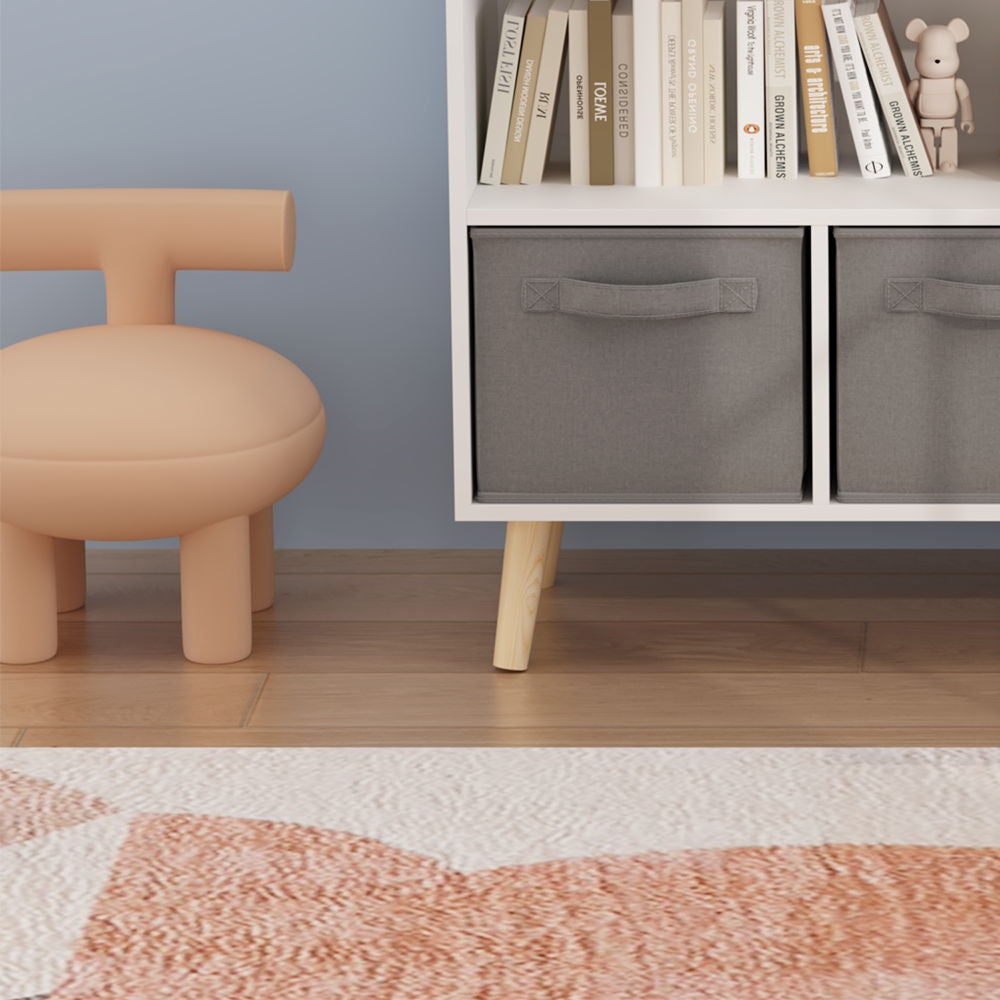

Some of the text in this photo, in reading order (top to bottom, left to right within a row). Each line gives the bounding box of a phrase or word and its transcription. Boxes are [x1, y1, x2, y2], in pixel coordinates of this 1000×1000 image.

[773, 0, 785, 78] ROWN ALCHEMIST
[803, 44, 823, 63] arts
[861, 14, 894, 86] ROWN ALCHEMIST
[774, 95, 785, 178] GROWN ALCHEMIS
[807, 79, 829, 132] architecture
[889, 102, 907, 132] GROWN
[900, 135, 921, 176] ALCHEMIS
